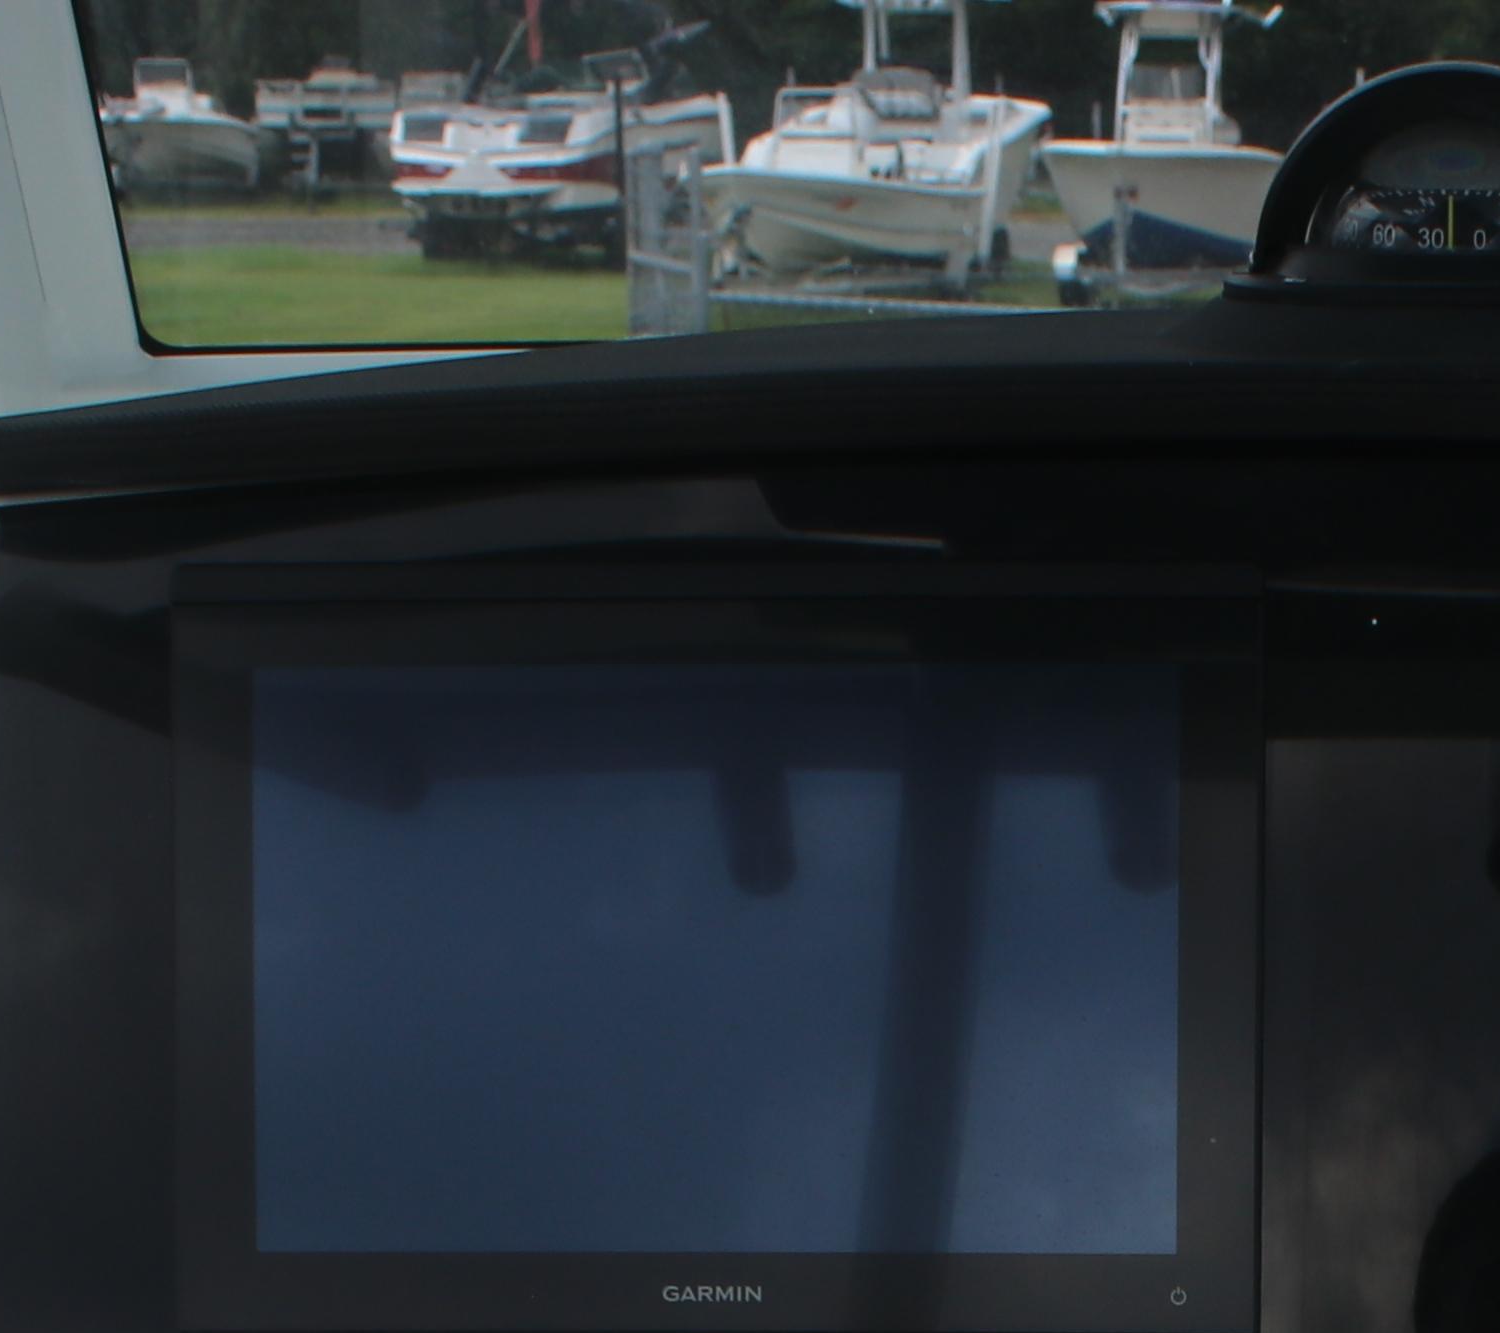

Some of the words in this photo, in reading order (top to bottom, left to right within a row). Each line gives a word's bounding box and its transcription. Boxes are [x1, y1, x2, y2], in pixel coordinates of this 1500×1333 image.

[1373, 224, 1396, 247] 60
[1417, 228, 1444, 248] 30
[1473, 229, 1487, 250] 0
[662, 1285, 761, 1301] GARMIN
